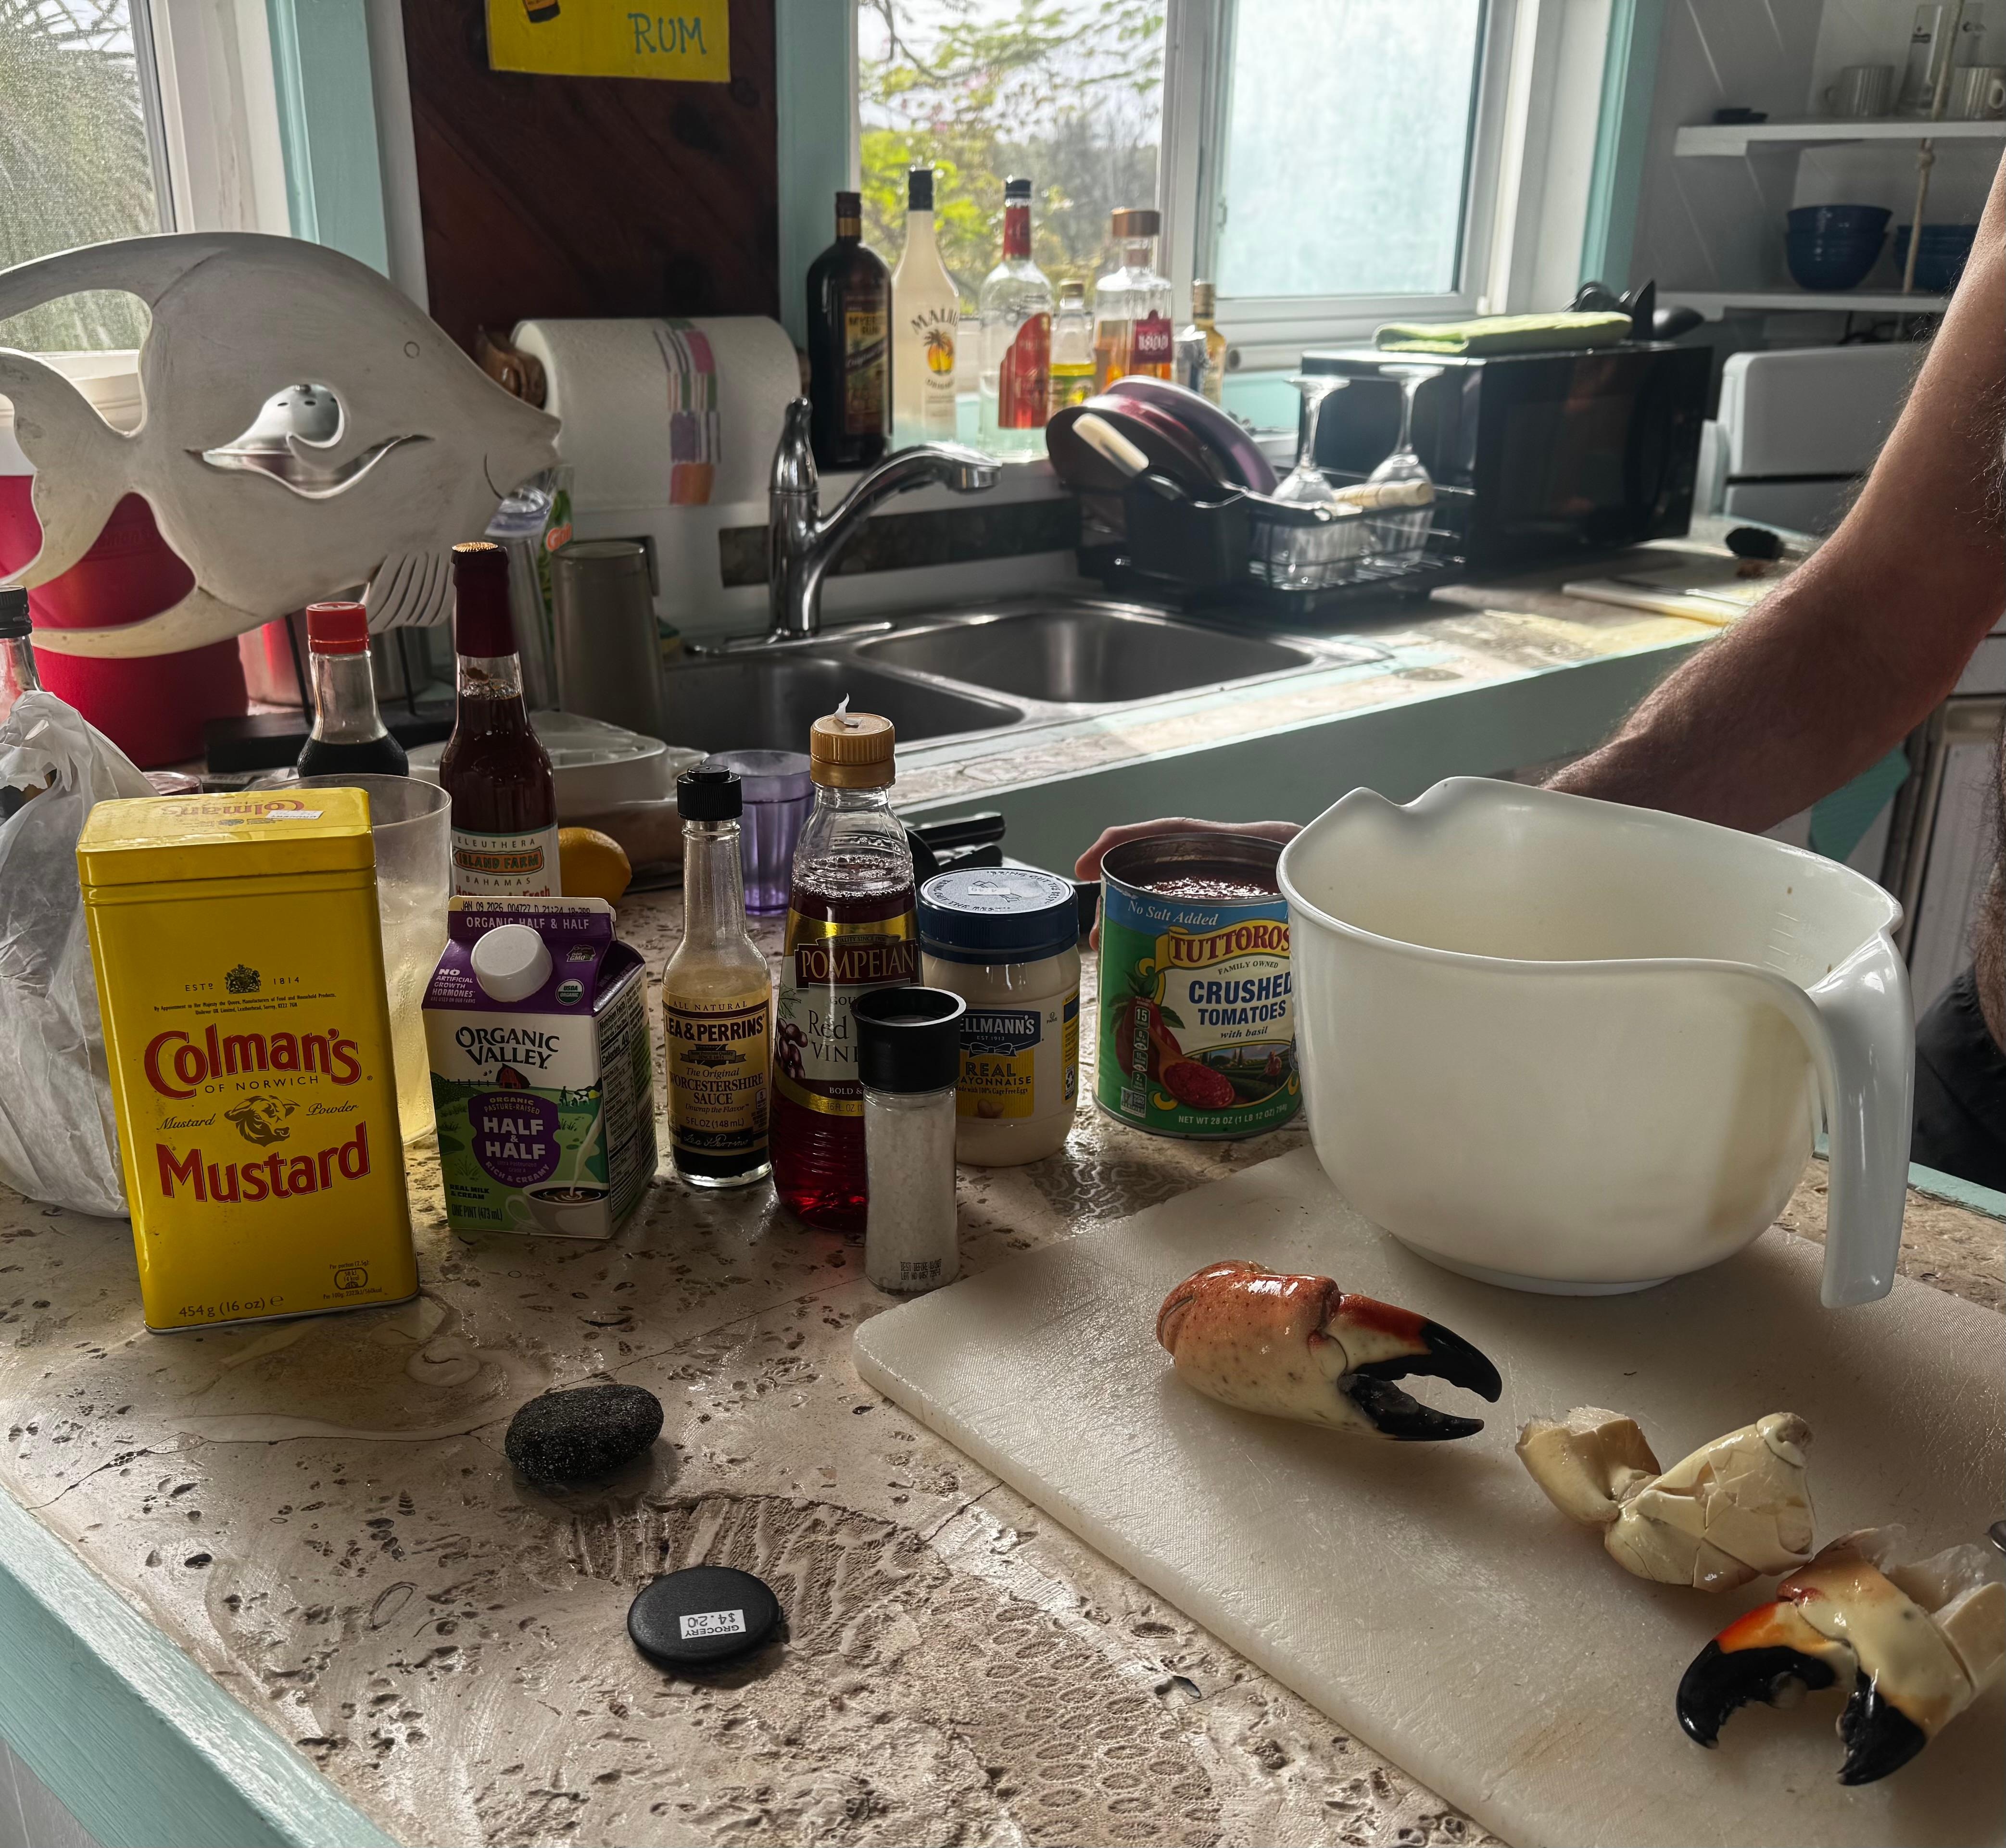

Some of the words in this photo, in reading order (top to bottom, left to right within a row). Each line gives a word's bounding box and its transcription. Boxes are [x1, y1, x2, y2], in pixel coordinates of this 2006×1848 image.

[628, 13, 707, 54] RUM
[458, 836, 535, 849] ELEUTHERA
[458, 852, 501, 869] ISLAND
[504, 854, 540, 869] FARM
[466, 876, 530, 887] BAHAMAS
[462, 900, 473, 912] JAN
[487, 902, 504, 912] 2026
[1128, 900, 1144, 915] No
[1146, 906, 1171, 921] Salt
[1173, 911, 1219, 926] Added
[519, 918, 545, 929] HALF
[551, 918, 558, 929] &
[563, 918, 590, 930] HALF
[801, 944, 914, 979] POMPEIAN
[1218, 961, 1250, 975] FAMILY
[1253, 960, 1279, 968] OWNED
[274, 977, 300, 985] 1814
[674, 1000, 689, 1010] ALL
[695, 1001, 747, 1011] NATURAL
[1198, 1000, 1286, 1026] TOMATOES
[1137, 1008, 1148, 1022] 15
[808, 1009, 850, 1040] Red
[1221, 1030, 1242, 1039] with
[1246, 1025, 1268, 1037] basil
[455, 1027, 560, 1053] ORGANIC
[144, 1023, 362, 1100] Colman's
[466, 1044, 554, 1069] VALLEY
[686, 1067, 701, 1077] The
[703, 1068, 740, 1080] Original
[965, 1061, 1016, 1078] REAL
[204, 1083, 225, 1094] OF
[236, 1075, 319, 1091] NORWICH
[669, 1071, 764, 1092] WORCESTERSHIRE
[960, 1076, 1032, 1086] AYONNAISE
[694, 1092, 733, 1105] SAUCE
[760, 1091, 764, 1100] 5
[830, 1087, 854, 1095] BOLD
[489, 1097, 534, 1106] ORGANIC
[685, 1103, 710, 1115] Unwrap
[155, 1113, 216, 1130] Mustard
[305, 1100, 359, 1117] Powder
[686, 1116, 690, 1124] 5
[691, 1118, 699, 1126] FL
[700, 1119, 711, 1128] OZ
[712, 1119, 729, 1129] (148
[730, 1117, 744, 1128] mL)
[1178, 1115, 1194, 1124] NET
[1196, 1117, 1209, 1125] WT
[1211, 1117, 1220, 1125] 28
[1223, 1116, 1233, 1124] OZ
[1235, 1115, 1242, 1125] (1
[1244, 1113, 1253, 1122] LB
[1255, 1112, 1263, 1120] 12
[1264, 1107, 1274, 1118] OZ)
[483, 1116, 544, 1135] HALF
[510, 1134, 519, 1143] &
[485, 1141, 546, 1160] HALF
[155, 1120, 371, 1203] Mustard
[485, 1161, 506, 1179] RICH
[515, 1164, 550, 1183] CREAMY
[450, 1183, 470, 1192] REAL
[457, 1192, 485, 1200] CREAM
[452, 1204, 463, 1217] ONE
[464, 1205, 477, 1219] PINT
[478, 1206, 491, 1220] (473
[491, 1207, 503, 1222] mL)
[901, 1272, 909, 1281] LOT
[220, 1301, 240, 1316] (16
[244, 1297, 265, 1311] oz)
[687, 1612, 736, 1628] $4.20
[685, 1624, 740, 1637] GROCERY
